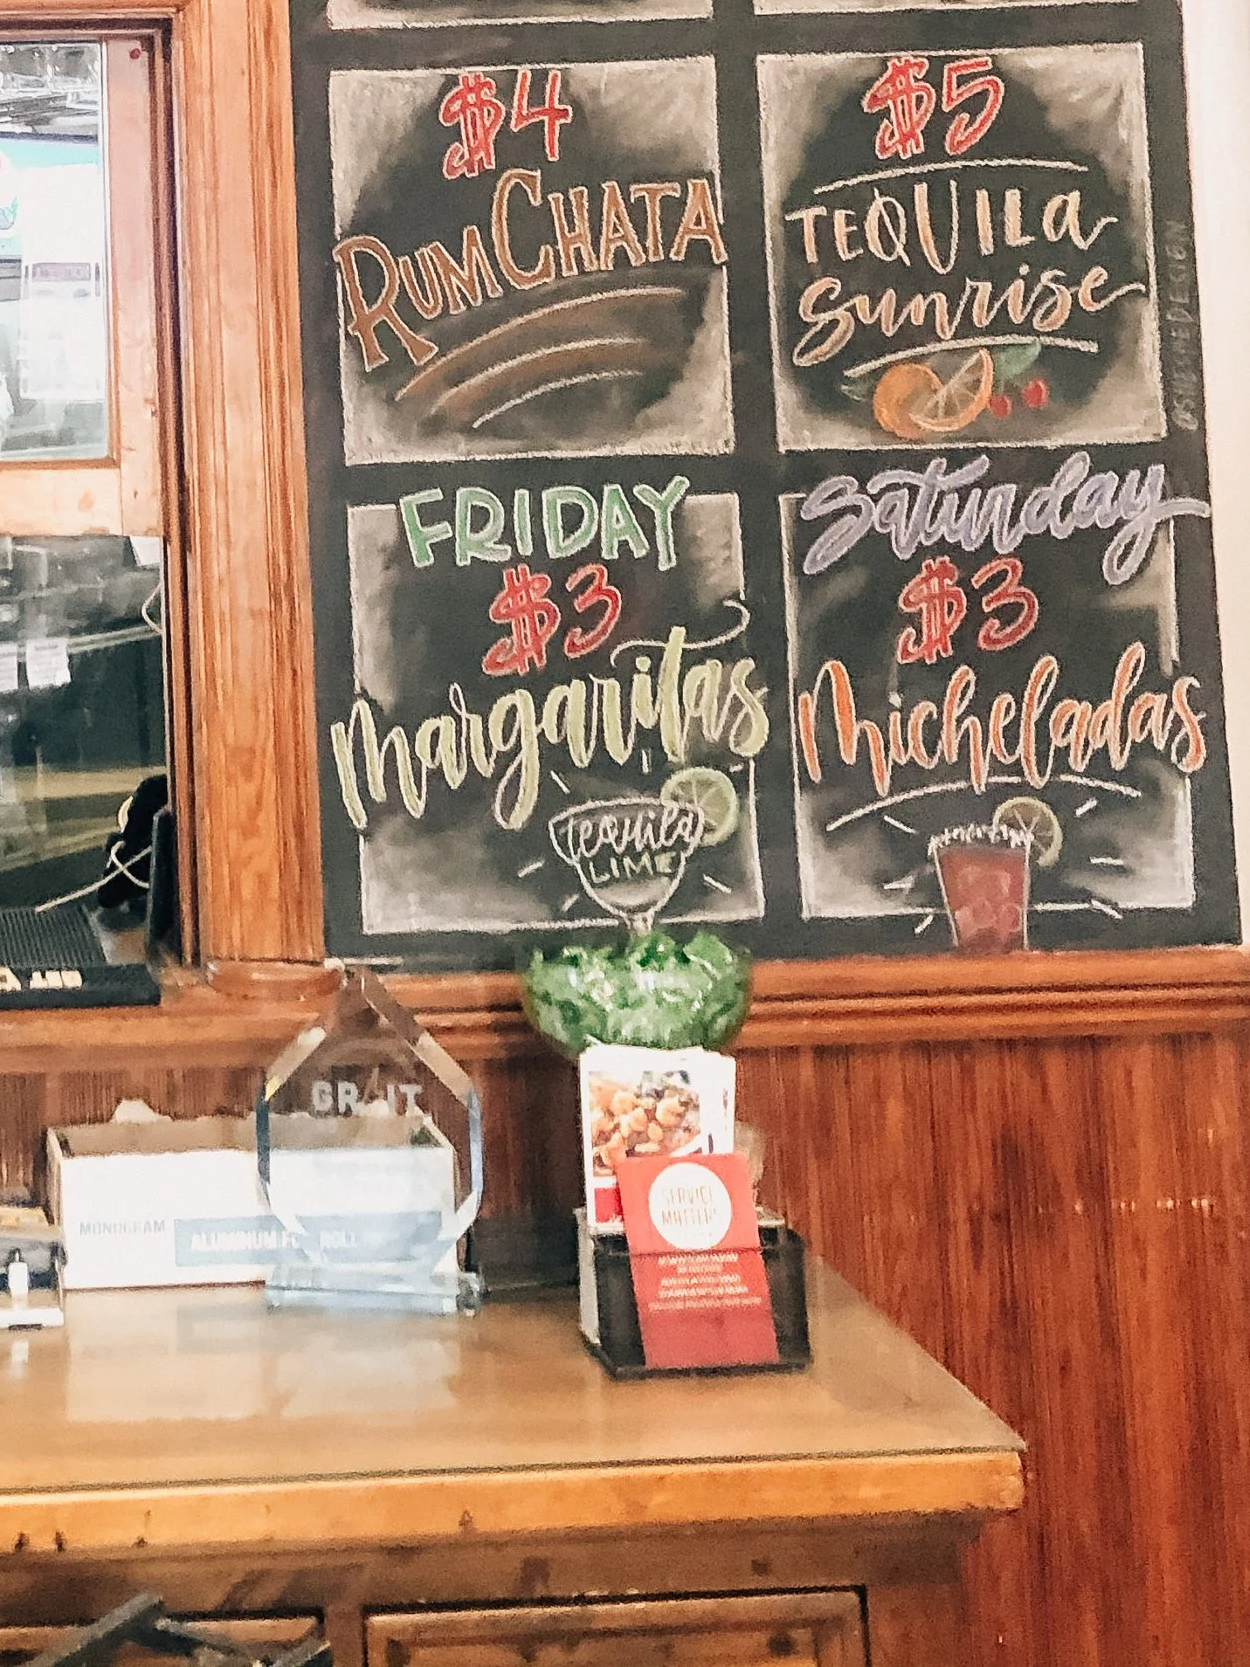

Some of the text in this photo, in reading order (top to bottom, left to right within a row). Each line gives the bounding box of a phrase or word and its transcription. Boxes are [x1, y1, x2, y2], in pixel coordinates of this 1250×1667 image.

[439, 69, 572, 181] $4
[862, 56, 1006, 161] $5
[398, 474, 690, 572] FRIDAY
[483, 562, 623, 676] $3
[897, 555, 1039, 665] $3
[798, 640, 1206, 797] Micheladas
[588, 851, 676, 883] LIME
